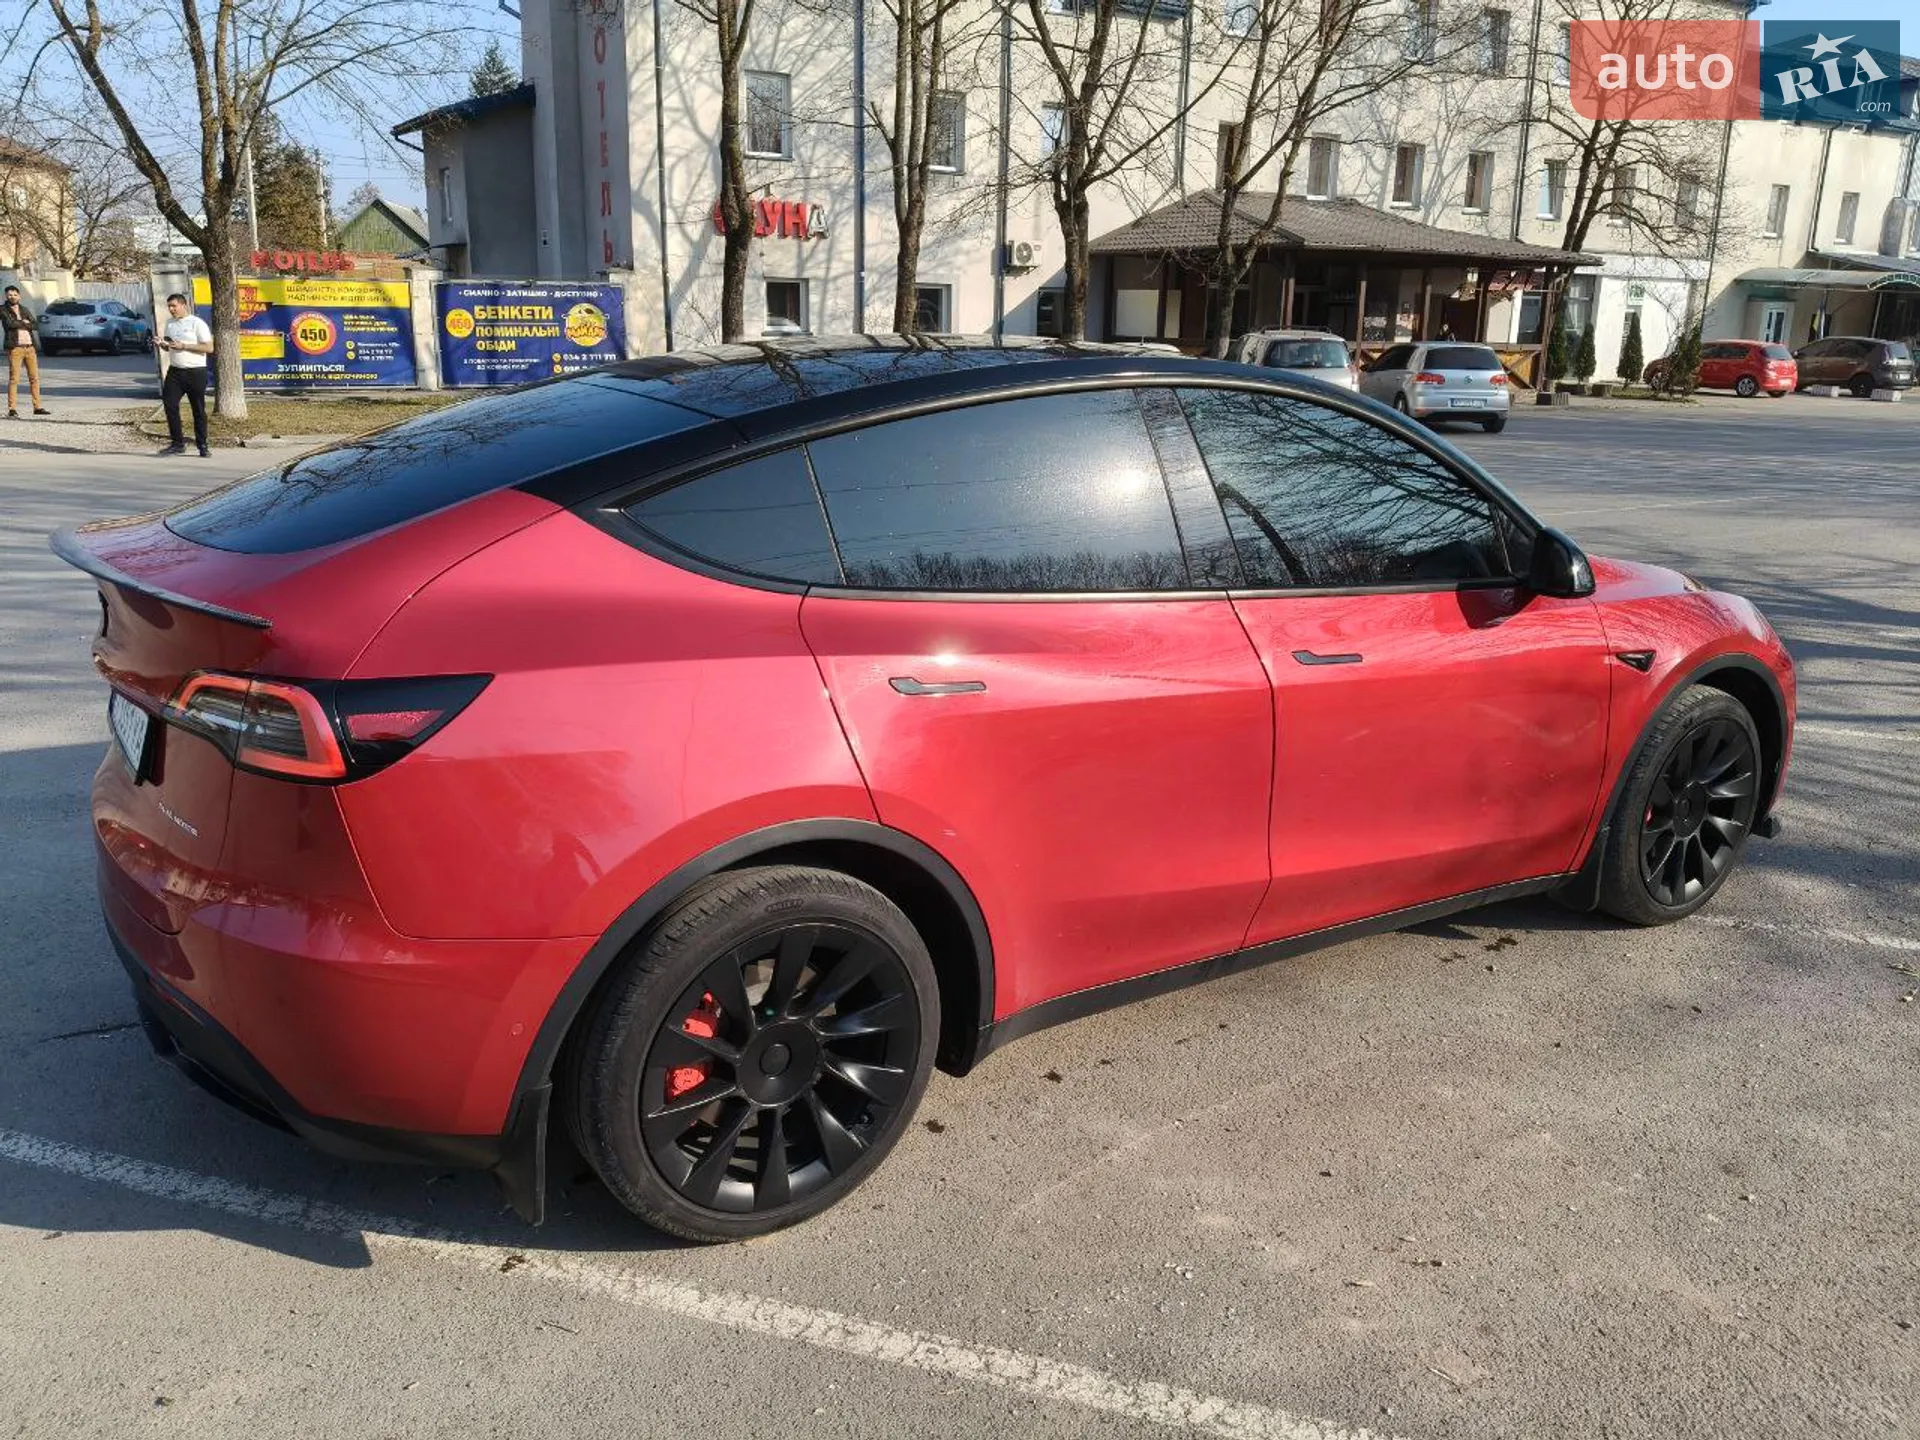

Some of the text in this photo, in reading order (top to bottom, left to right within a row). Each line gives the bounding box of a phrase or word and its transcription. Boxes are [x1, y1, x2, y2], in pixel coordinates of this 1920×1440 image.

[592, 0, 613, 264] ОТЕЛЬ
[463, 289, 599, 299] СМАЧНО ЗАТИШНО ДОСТУПНО
[474, 305, 553, 320] БЕНКЕТИ
[300, 328, 328, 342] 450
[475, 325, 560, 338] ПОМИНАЛЬНІ
[476, 340, 516, 352] ОБІДИ
